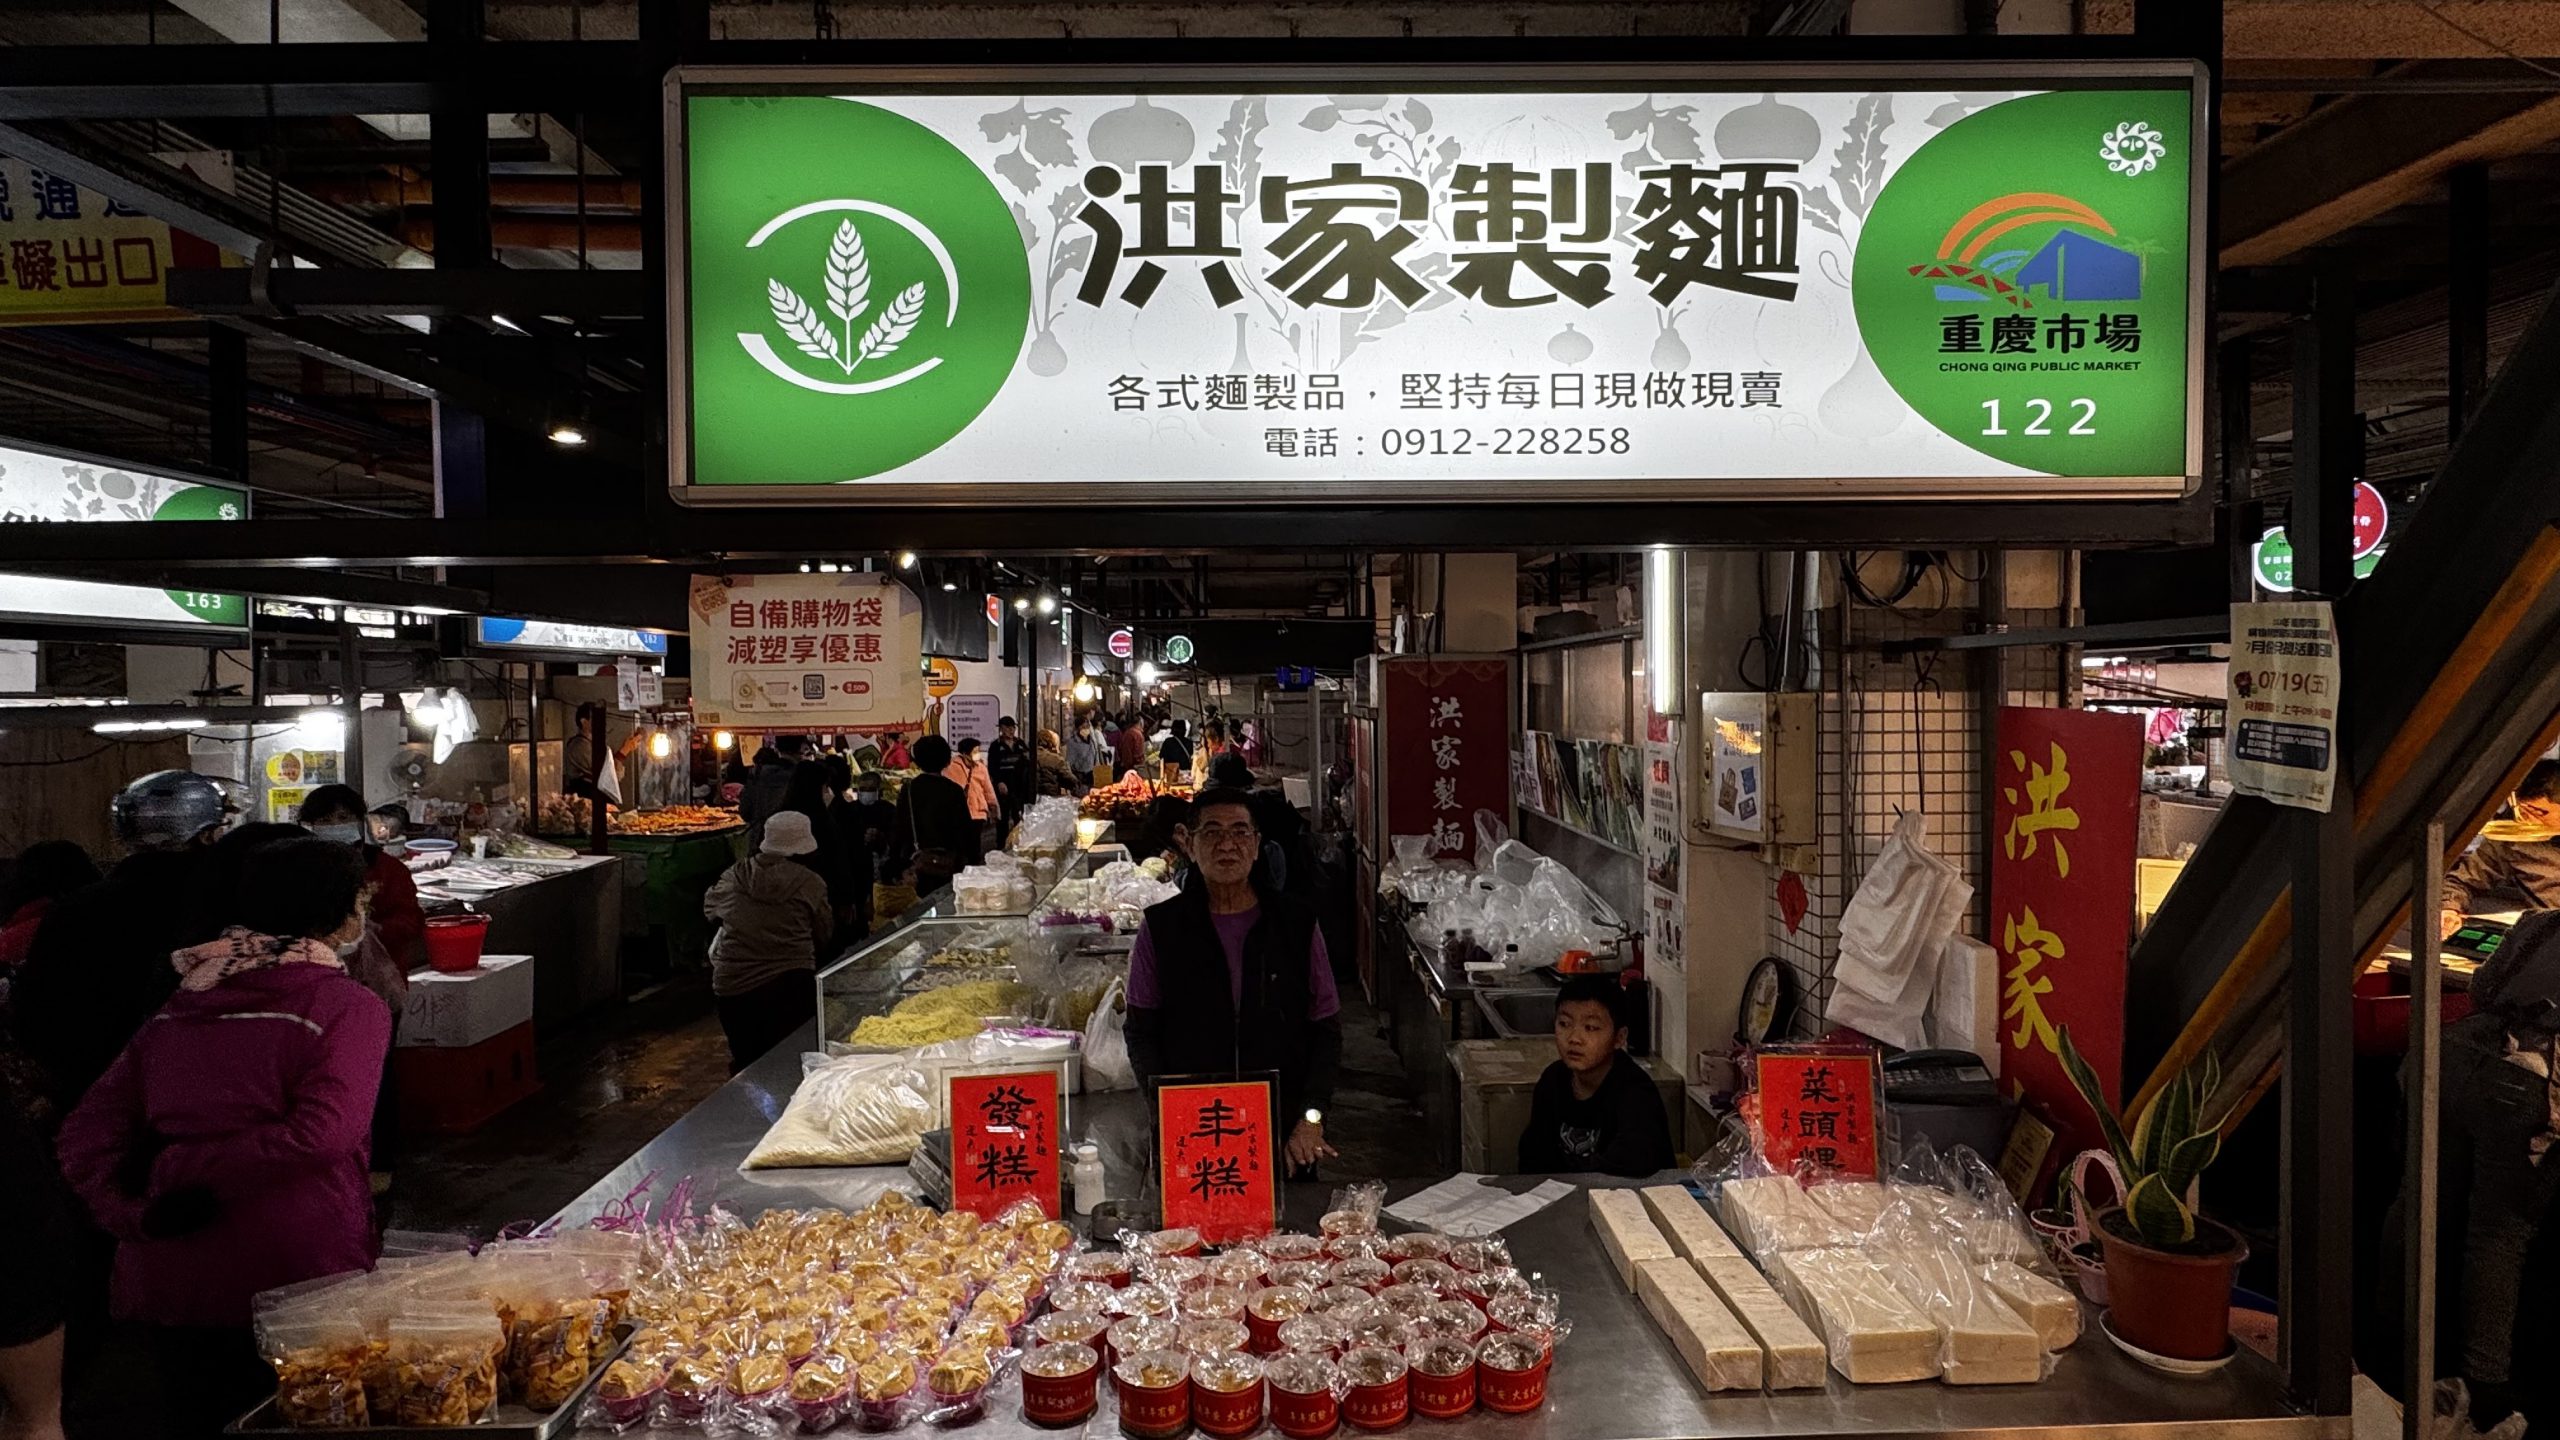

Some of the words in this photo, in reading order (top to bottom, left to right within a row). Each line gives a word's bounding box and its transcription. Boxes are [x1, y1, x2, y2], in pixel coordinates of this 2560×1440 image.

[1076, 162, 1800, 310] 洪家製麵
[0, 237, 159, 291] 礙出口
[1938, 313, 2142, 355] 重慶市場
[1939, 361, 1989, 373] CHONG
[1992, 361, 2026, 374] QING
[2030, 361, 2080, 372] PUBLIC
[2083, 361, 2142, 372] MARKET
[186, 592, 222, 609] 163
[730, 598, 882, 629] 自備購物袋
[727, 633, 882, 664] 減塑享優惠
[2003, 740, 2080, 1104] 洪家
[975, 1085, 1039, 1190] 發糕
